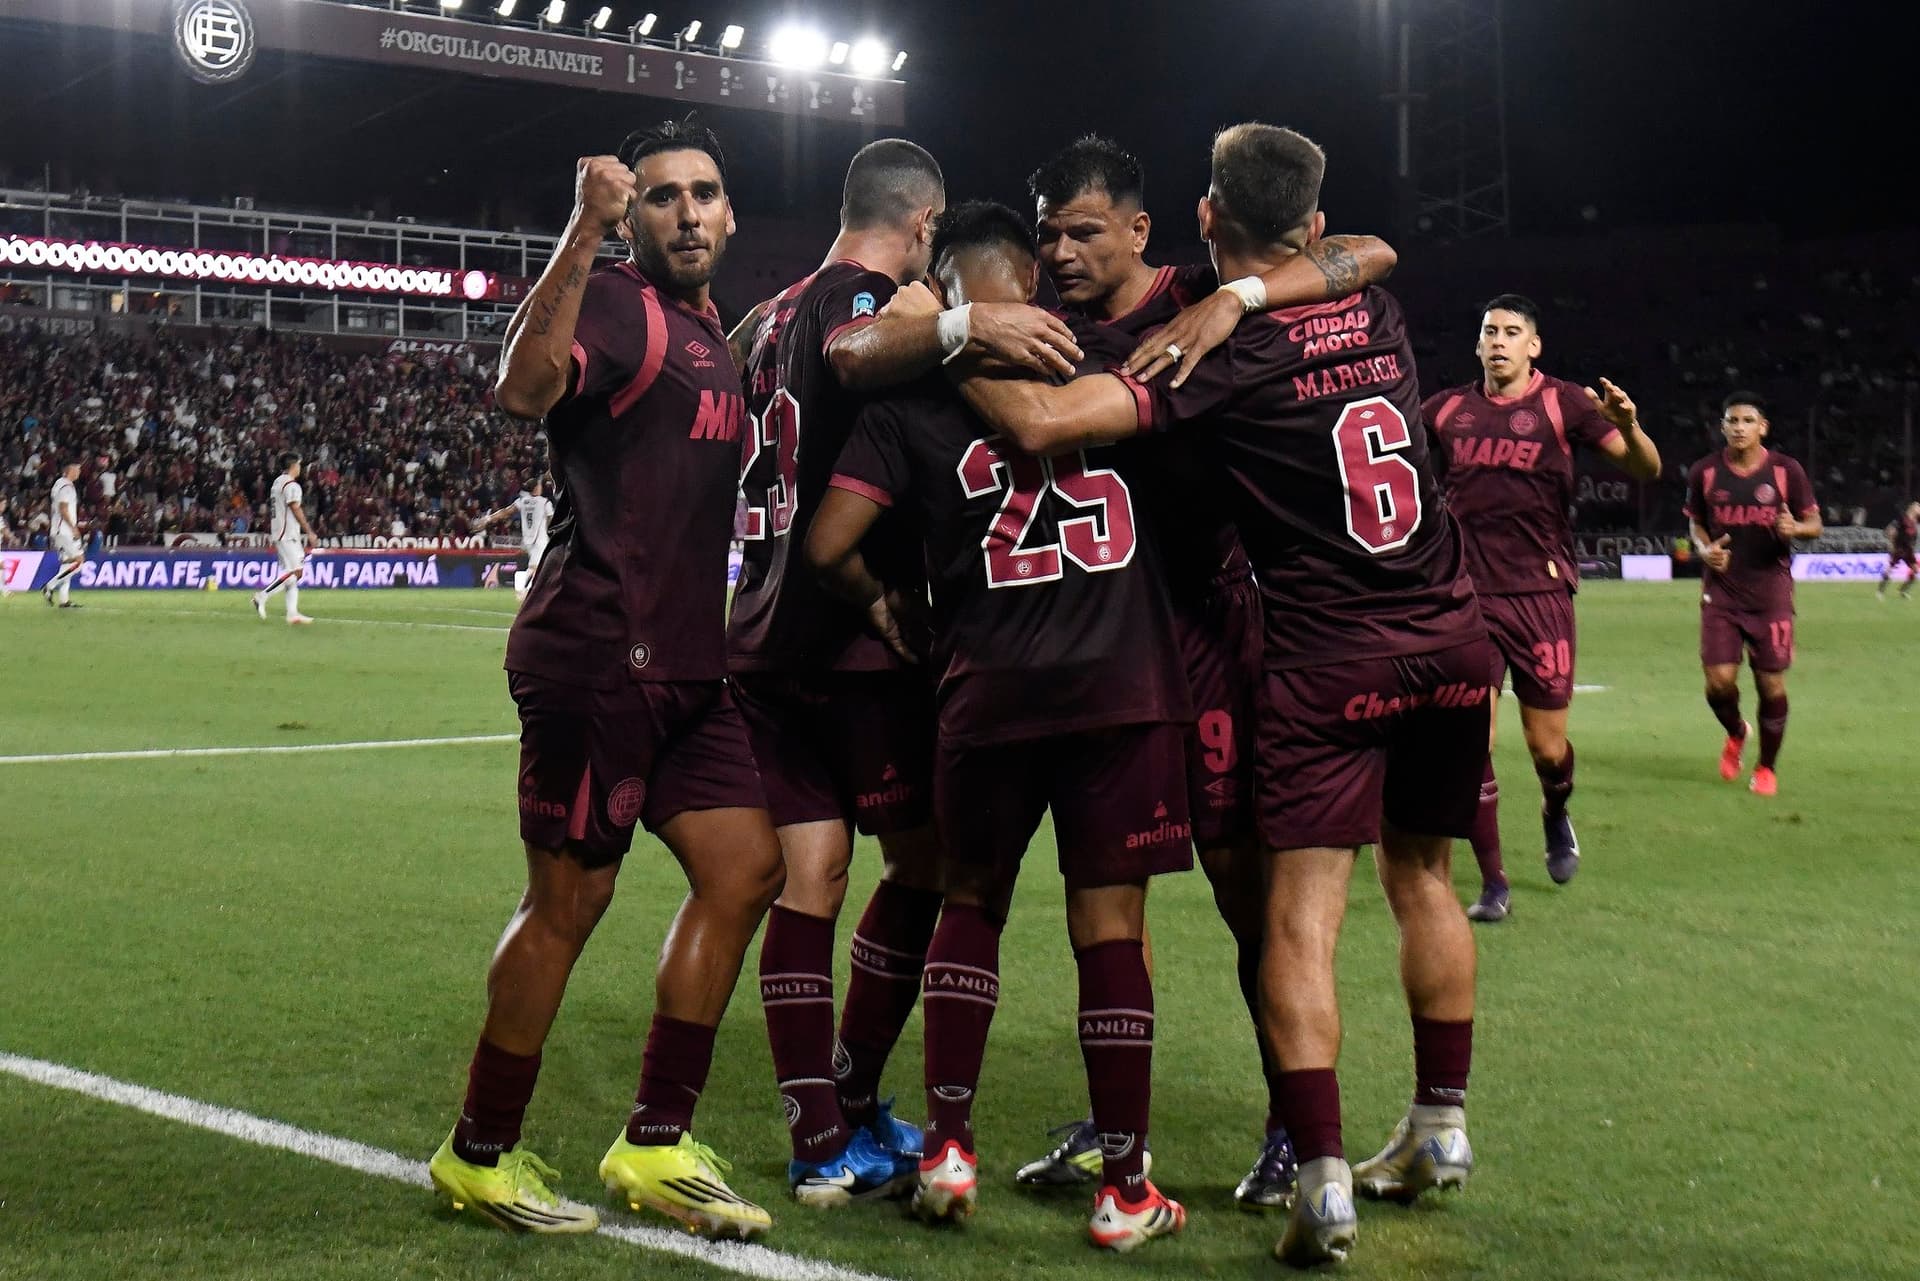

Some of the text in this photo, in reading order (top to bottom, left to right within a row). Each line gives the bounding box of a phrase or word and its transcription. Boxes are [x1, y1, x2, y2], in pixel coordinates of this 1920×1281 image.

[379, 26, 603, 76] #ORGULLOGRANATE
[1288, 310, 1370, 343] CIUDAD
[1303, 331, 1369, 360] MOTO
[1292, 354, 1402, 401] MARCICH
[1452, 437, 1543, 471] MAPEI
[1331, 395, 1422, 554] 6
[956, 434, 1136, 589] 25
[79, 560, 168, 586] SANTA
[171, 560, 207, 588] FE,
[215, 554, 338, 589] TUCUÁN,
[1532, 638, 1570, 678] 30
[1198, 709, 1238, 773] 9
[1126, 821, 1191, 848] andina
[928, 972, 999, 995] LANÚS
[640, 1124, 680, 1134] TIFOX
[804, 1125, 840, 1147] TIFOX
